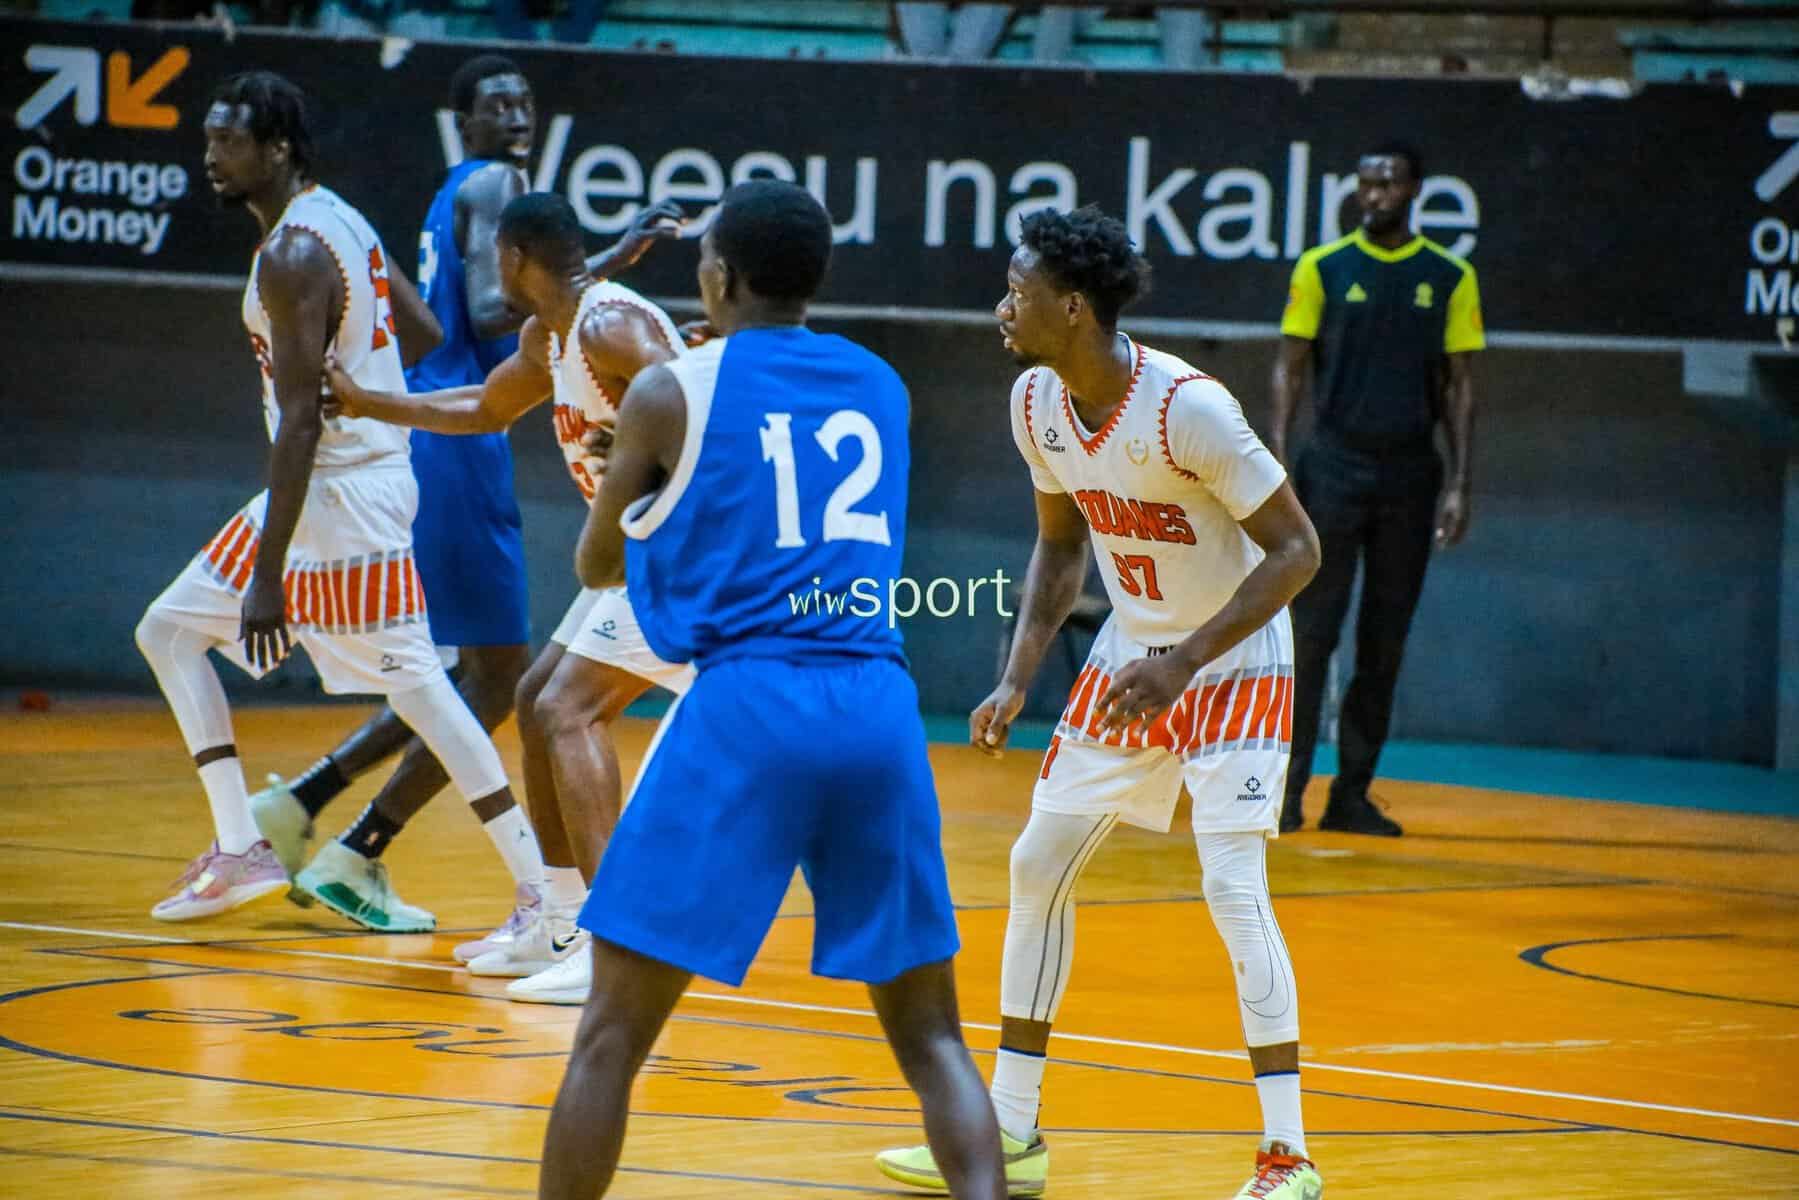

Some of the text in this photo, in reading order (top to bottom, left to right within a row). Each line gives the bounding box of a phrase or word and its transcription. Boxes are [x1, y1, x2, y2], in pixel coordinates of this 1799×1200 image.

[15, 145, 189, 206] Orange
[924, 158, 1078, 248] na
[13, 194, 171, 254] Money
[759, 410, 891, 548] 12
